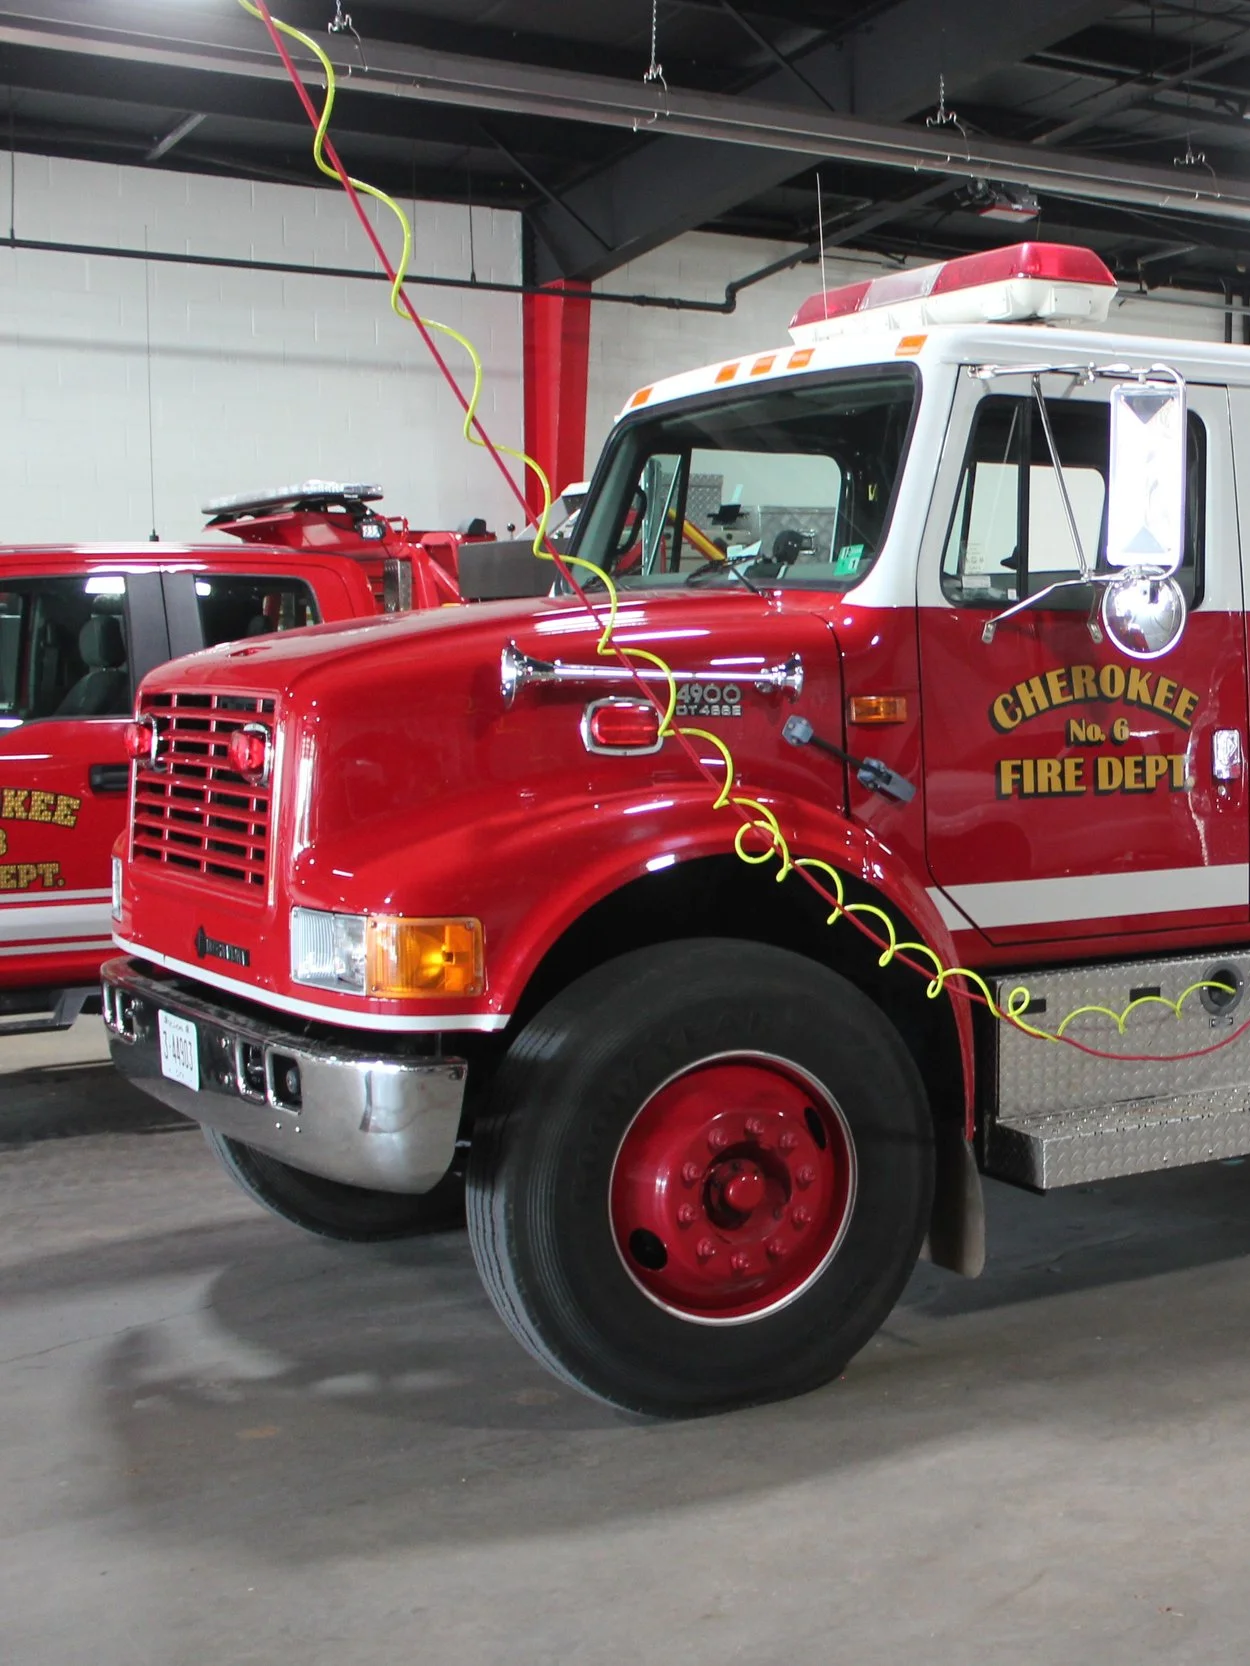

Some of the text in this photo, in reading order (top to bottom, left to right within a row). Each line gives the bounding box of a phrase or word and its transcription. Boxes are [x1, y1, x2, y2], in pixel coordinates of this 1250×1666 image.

[677, 683, 741, 704] 4900
[990, 663, 1199, 731] CHEROKEE
[1067, 717, 1130, 744] No. 6
[998, 757, 1087, 797] FIRE
